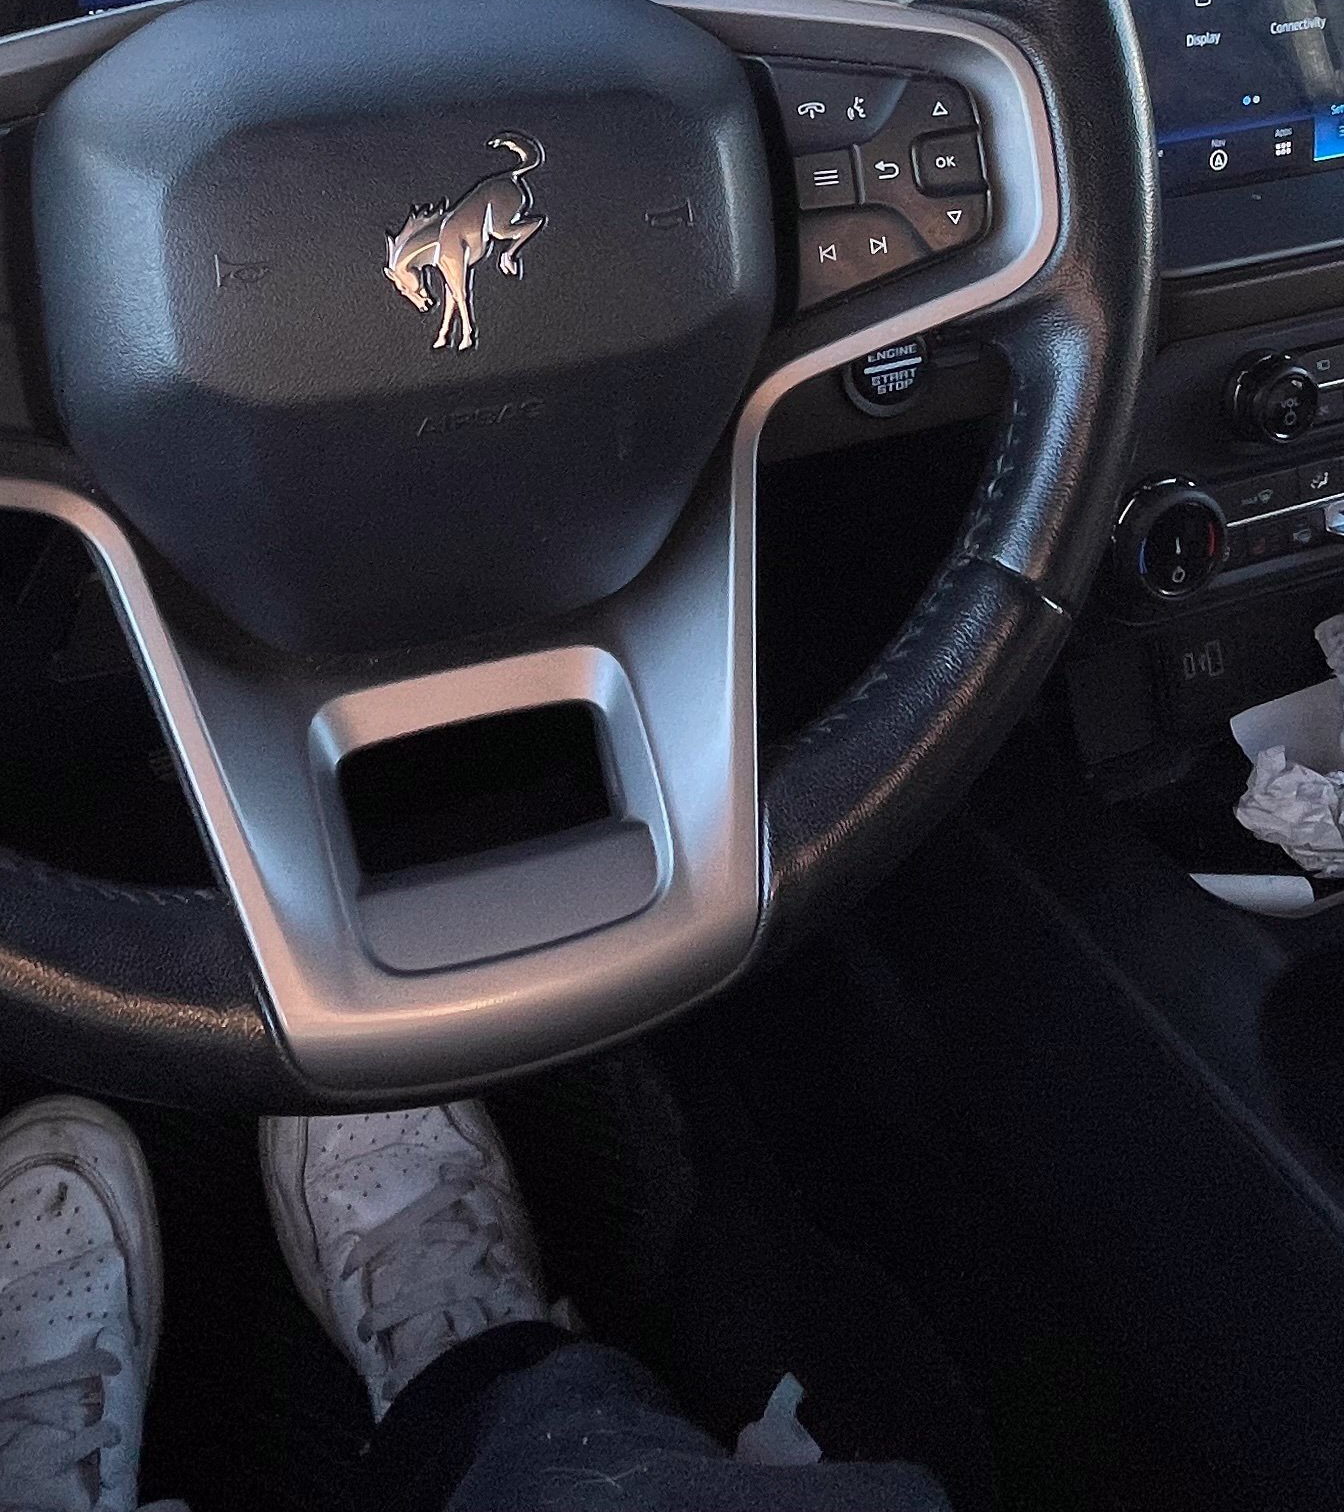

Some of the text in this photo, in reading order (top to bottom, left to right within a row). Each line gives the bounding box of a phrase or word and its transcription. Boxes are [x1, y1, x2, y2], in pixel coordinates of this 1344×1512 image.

[1270, 15, 1327, 35] Connectivity
[1186, 31, 1222, 48] Display
[935, 155, 956, 169] OK
[867, 343, 918, 363] ENGINE
[871, 368, 917, 386] START
[877, 378, 914, 395] STOP
